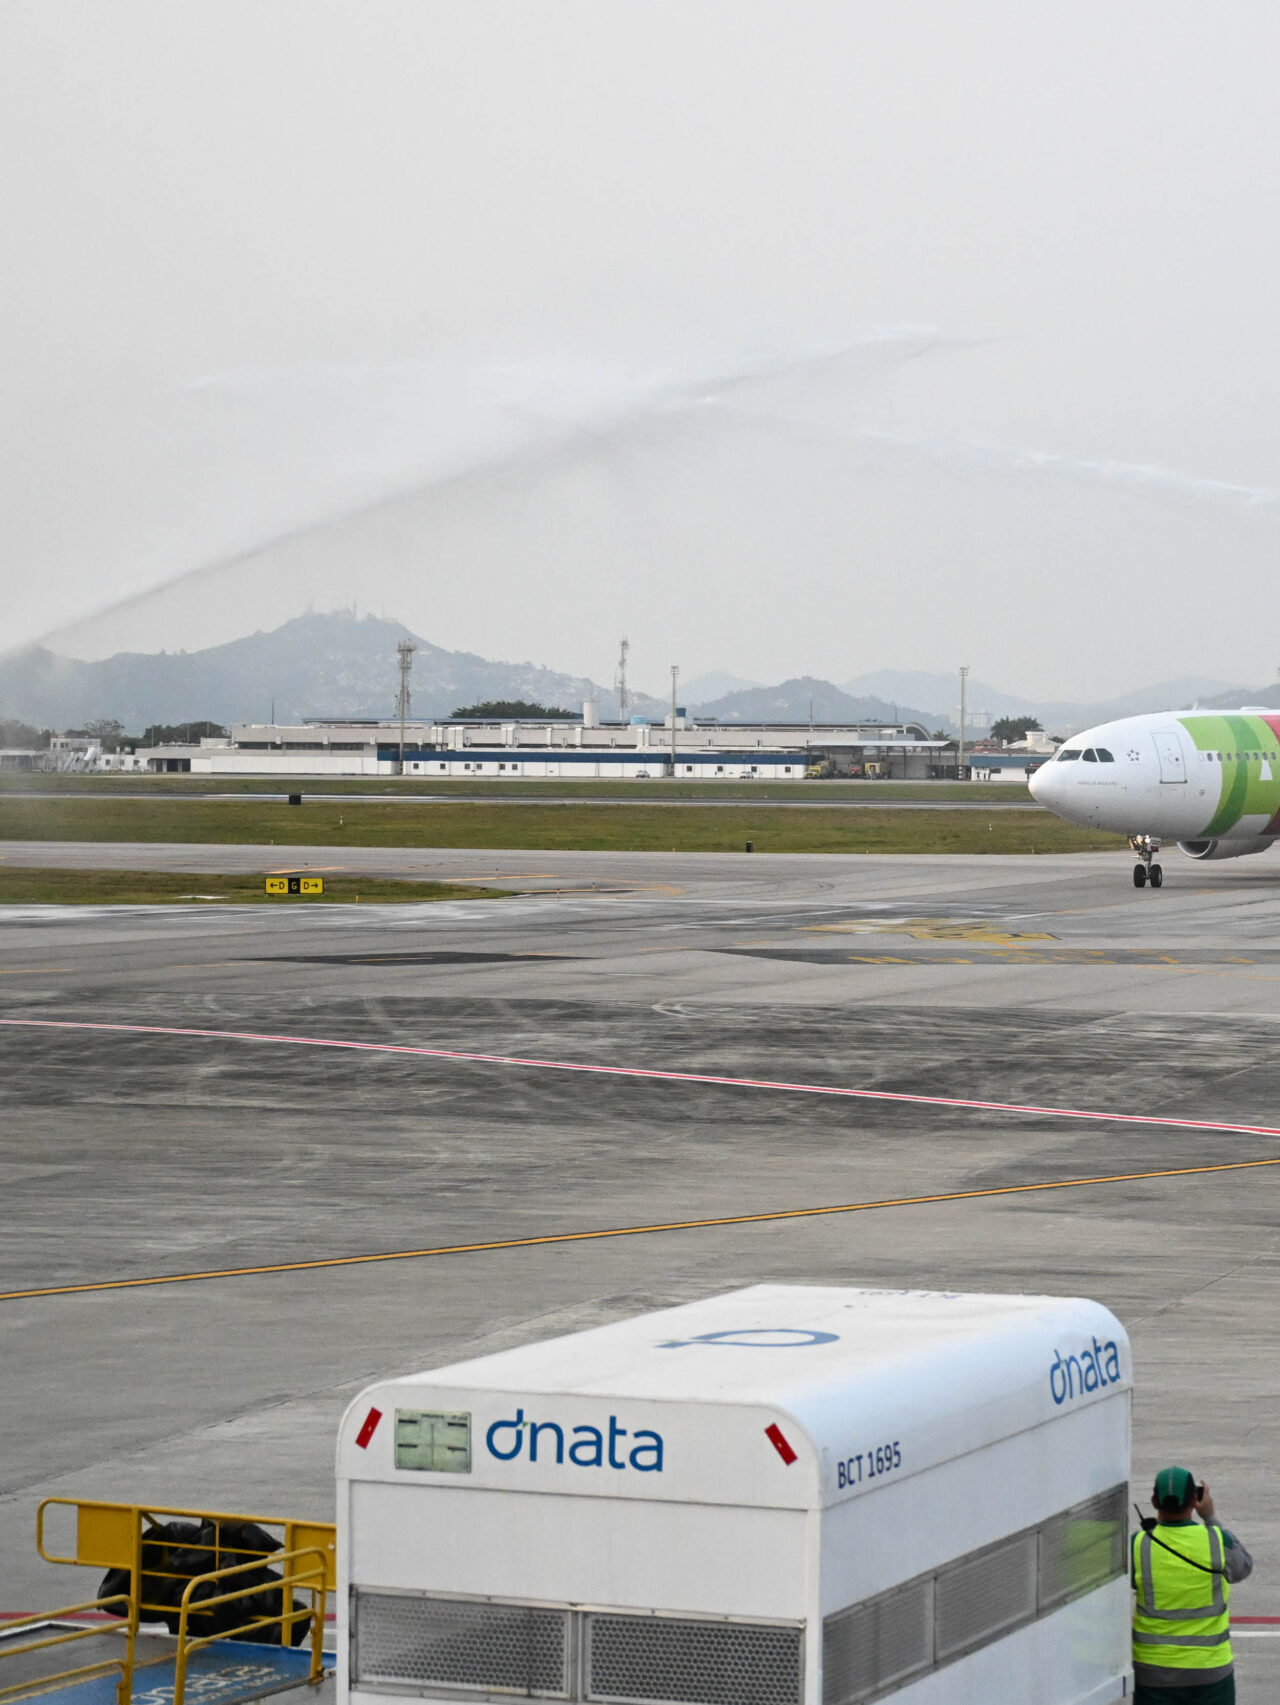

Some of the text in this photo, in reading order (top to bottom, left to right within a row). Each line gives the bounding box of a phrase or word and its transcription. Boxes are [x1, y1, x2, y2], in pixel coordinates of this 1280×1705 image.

[279, 881, 285, 890] D
[291, 881, 297, 890] G
[304, 881, 310, 890] D
[1050, 1336, 1120, 1405] dnata
[486, 1408, 664, 1472] dnata
[838, 1441, 901, 1489] BCT 1695
